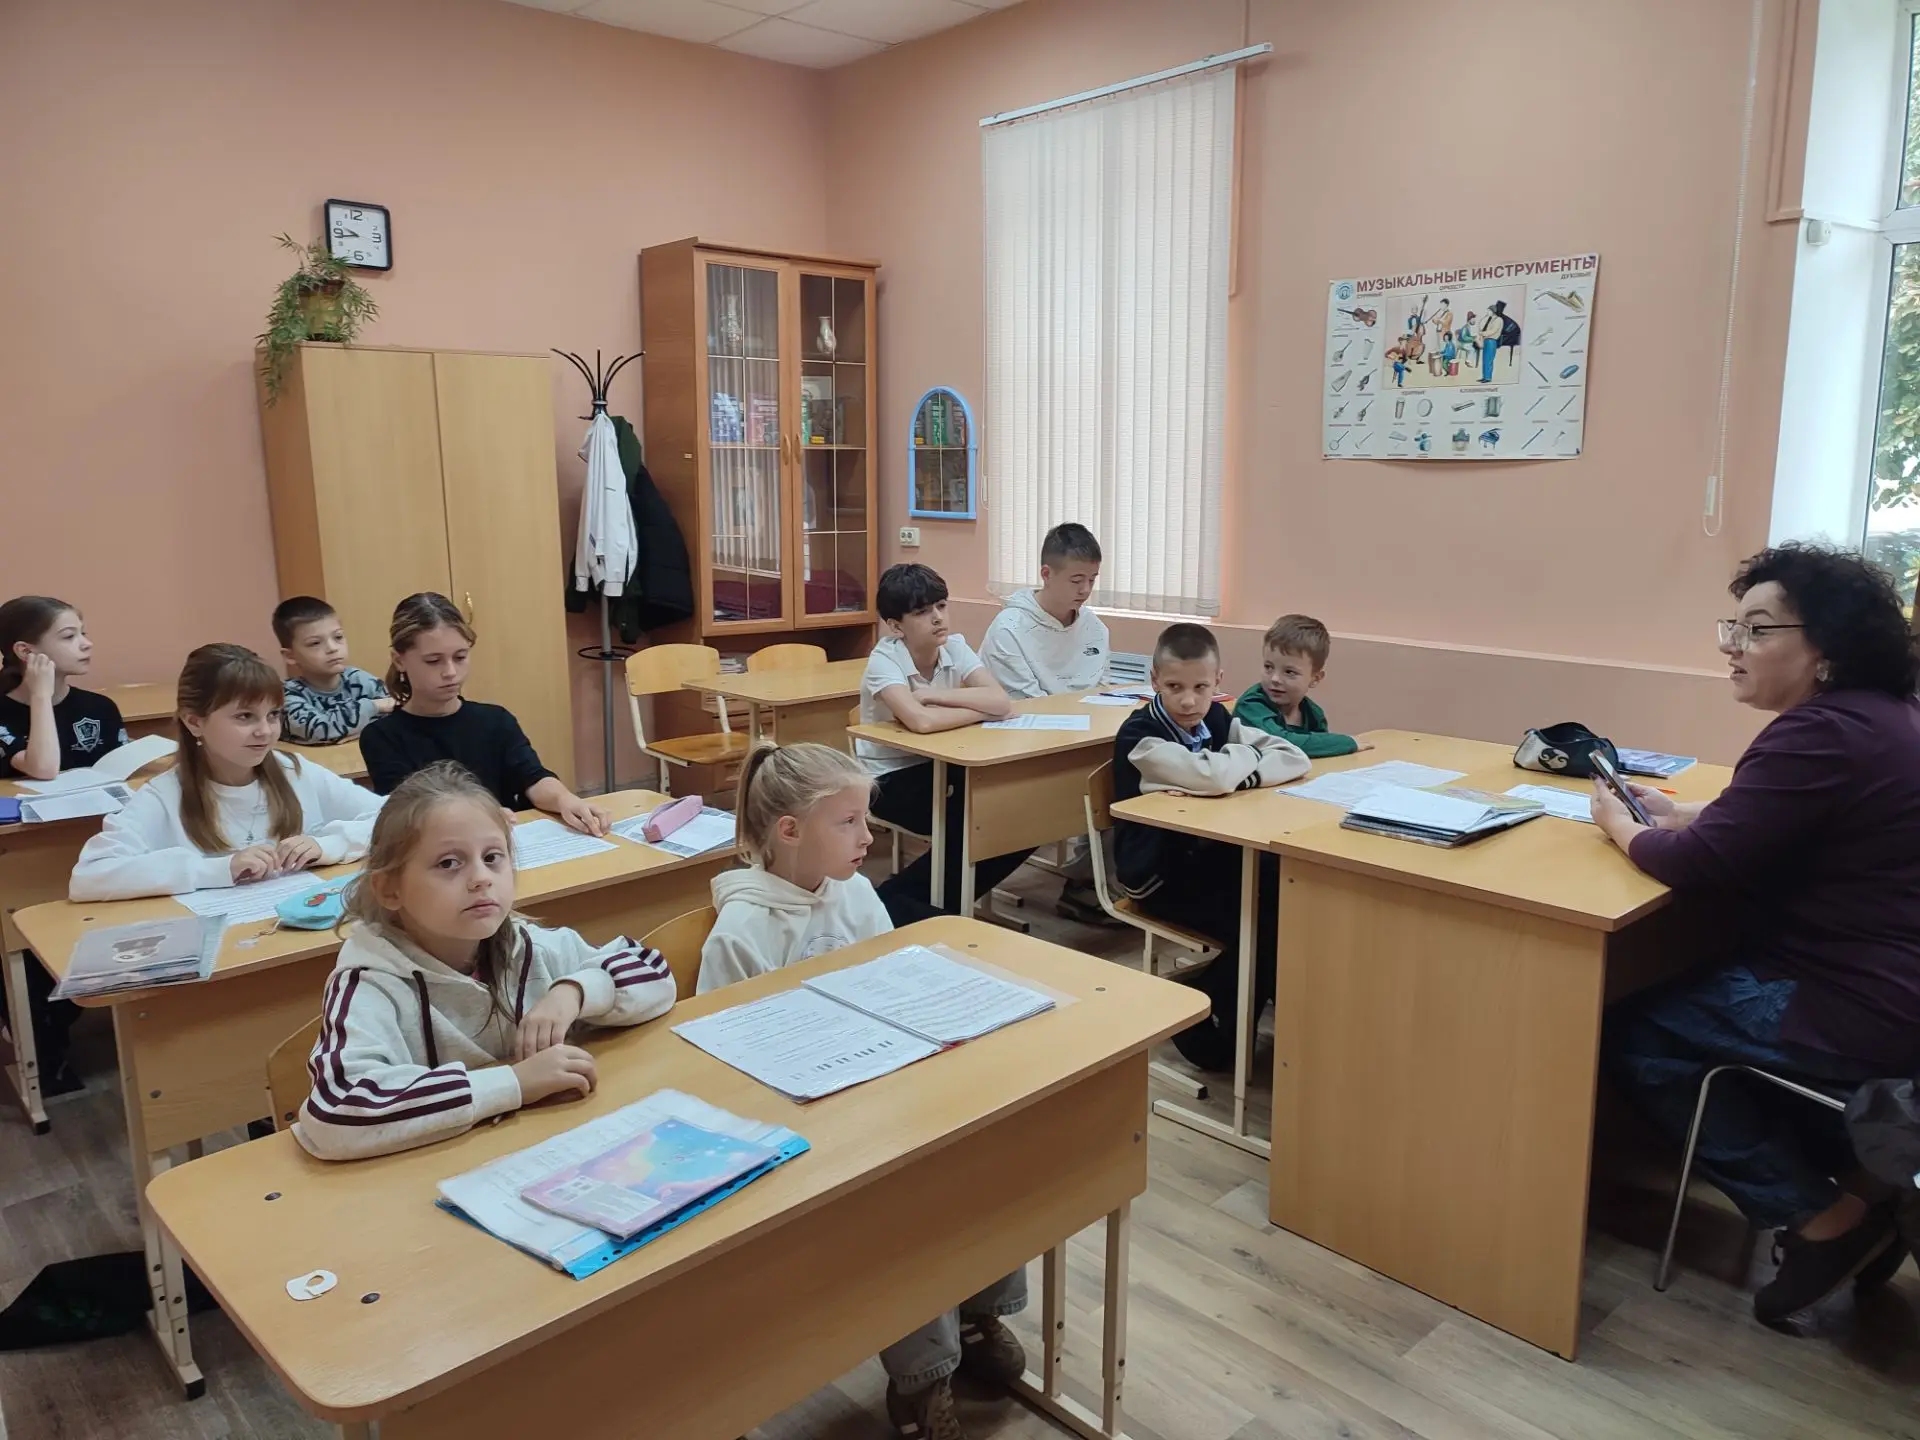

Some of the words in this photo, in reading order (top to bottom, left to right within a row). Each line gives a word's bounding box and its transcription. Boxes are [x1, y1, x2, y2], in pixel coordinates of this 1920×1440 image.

[350, 209, 363, 221] 12
[333, 227, 344, 238] 9
[372, 232, 382, 243] 3
[354, 250, 364, 261] 6
[1356, 269, 1468, 293] МУЗЫКАЛЬНЫЕ
[1471, 256, 1597, 280] ИНСТРУМЕНТЫ
